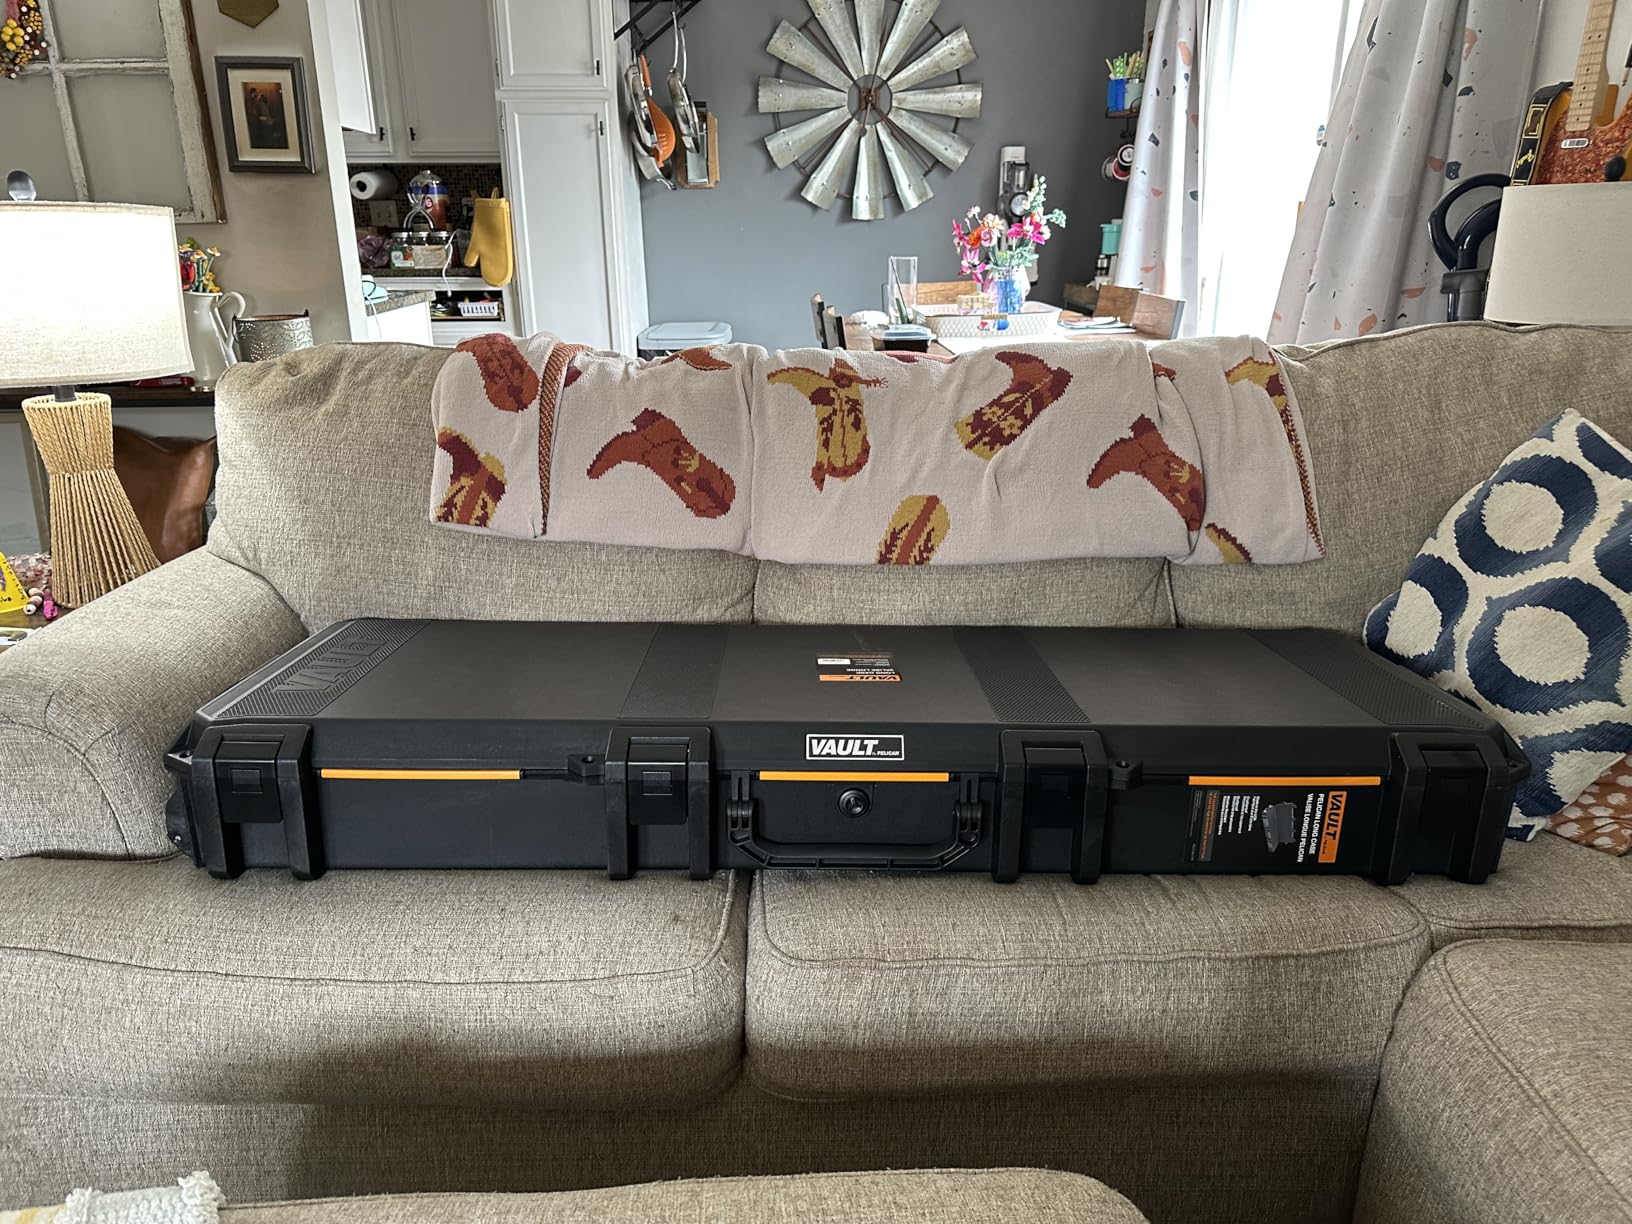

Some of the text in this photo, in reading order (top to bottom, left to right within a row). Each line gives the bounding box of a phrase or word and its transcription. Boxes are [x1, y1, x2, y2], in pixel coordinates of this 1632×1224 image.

[811, 739, 879, 756] VAULT
[1297, 793, 1314, 863] VALISE LONGUE PELICAN
[1308, 793, 1325, 855] PELICAN LONG CASE
[1327, 794, 1343, 841] VAULT
